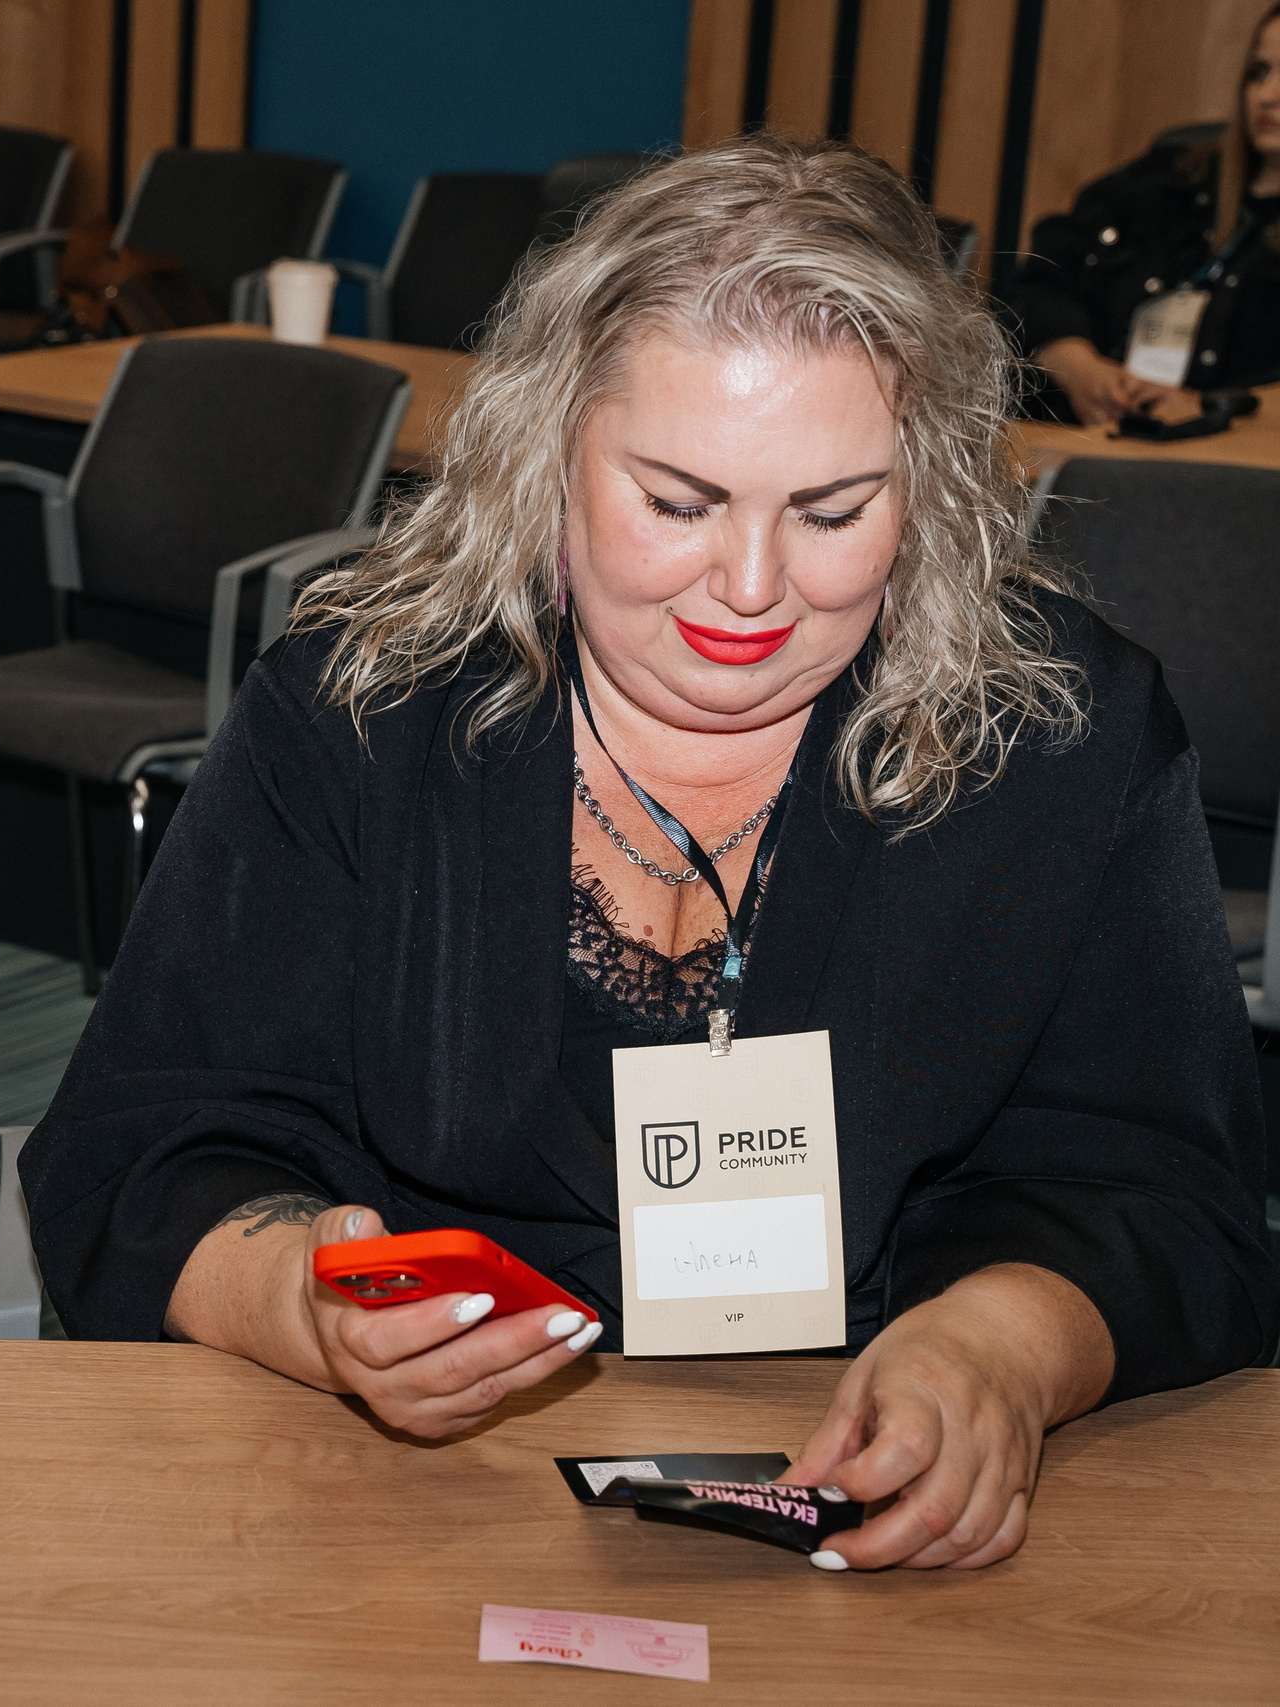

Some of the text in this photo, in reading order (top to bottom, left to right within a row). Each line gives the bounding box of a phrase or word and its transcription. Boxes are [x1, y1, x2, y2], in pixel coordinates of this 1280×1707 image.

[719, 1126, 807, 1154] PRIDE
[719, 1152, 808, 1170] COMMUNITY
[725, 1313, 744, 1323] VIP
[686, 1485, 818, 1526] ЕКАТЕРИНА
